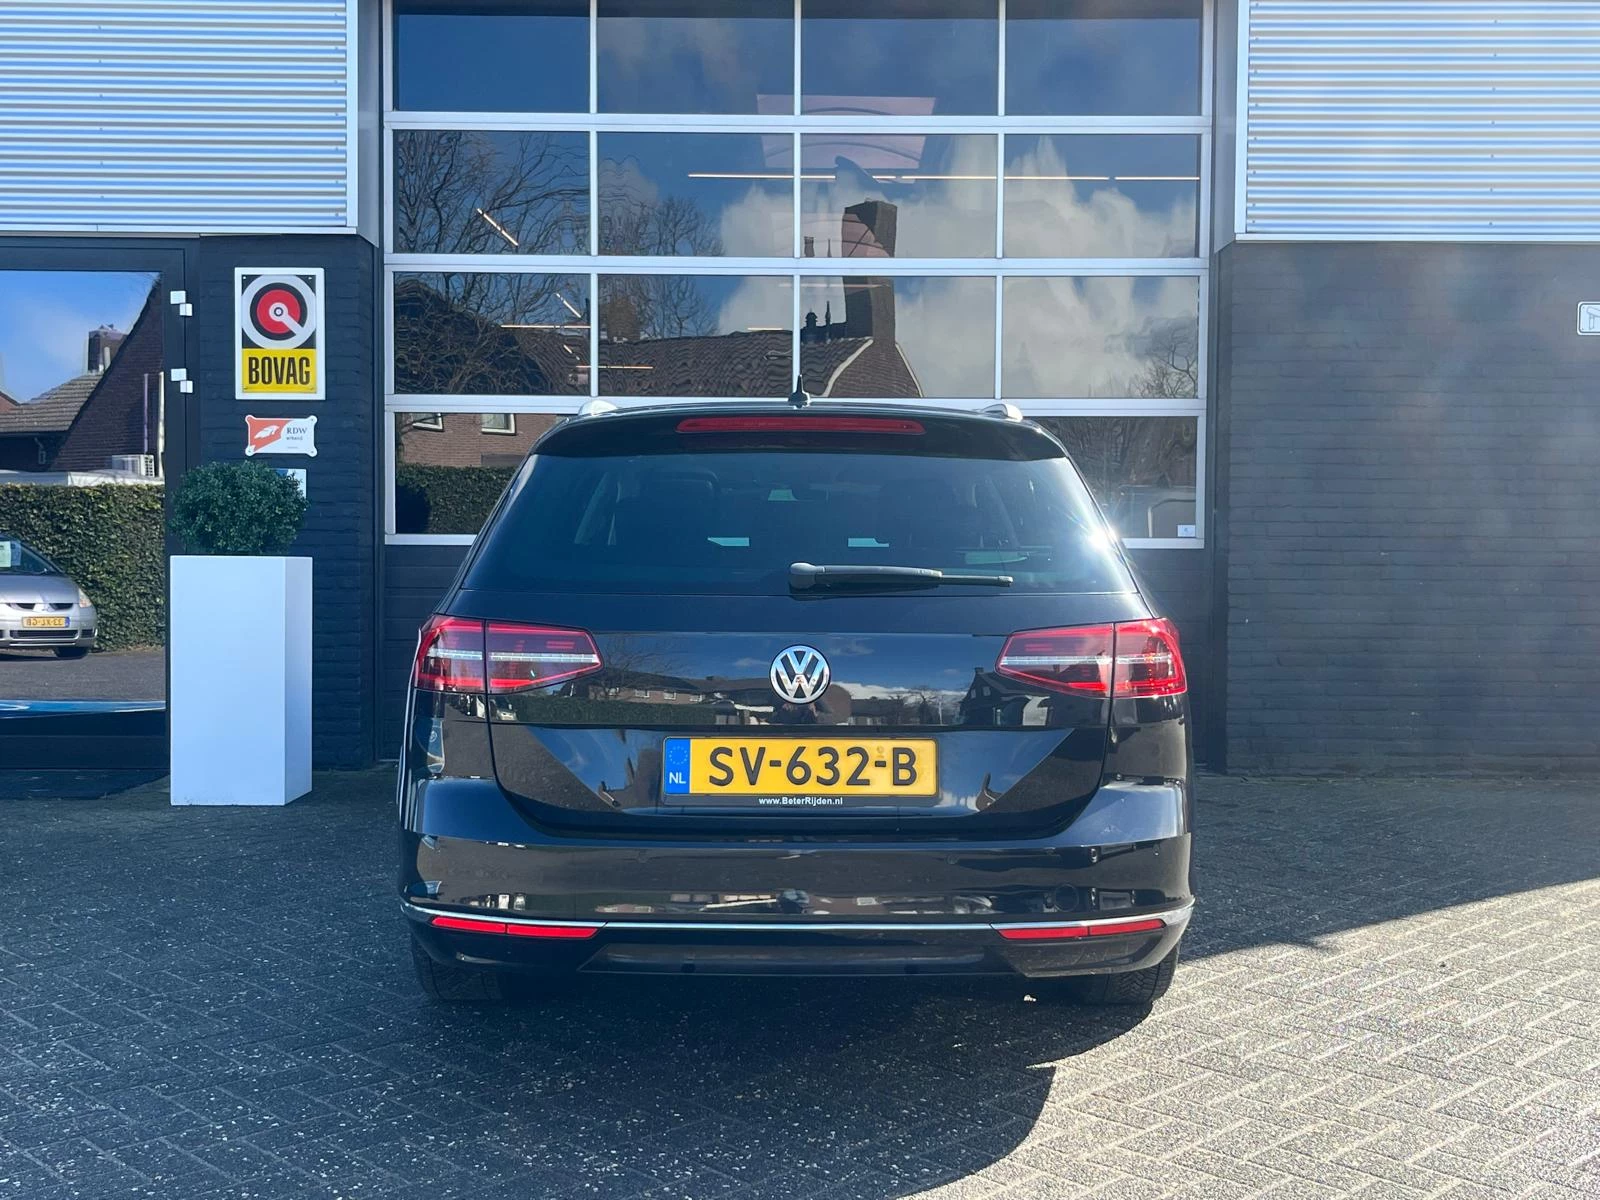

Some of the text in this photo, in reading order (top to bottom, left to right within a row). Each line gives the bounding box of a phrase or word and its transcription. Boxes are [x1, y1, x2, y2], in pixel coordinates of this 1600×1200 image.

[248, 356, 310, 385] BOVAG
[771, 646, 829, 702] VW
[669, 772, 686, 784] NL
[709, 746, 917, 786] SV-632-B
[758, 796, 843, 807] www.BeterRijden.nl
